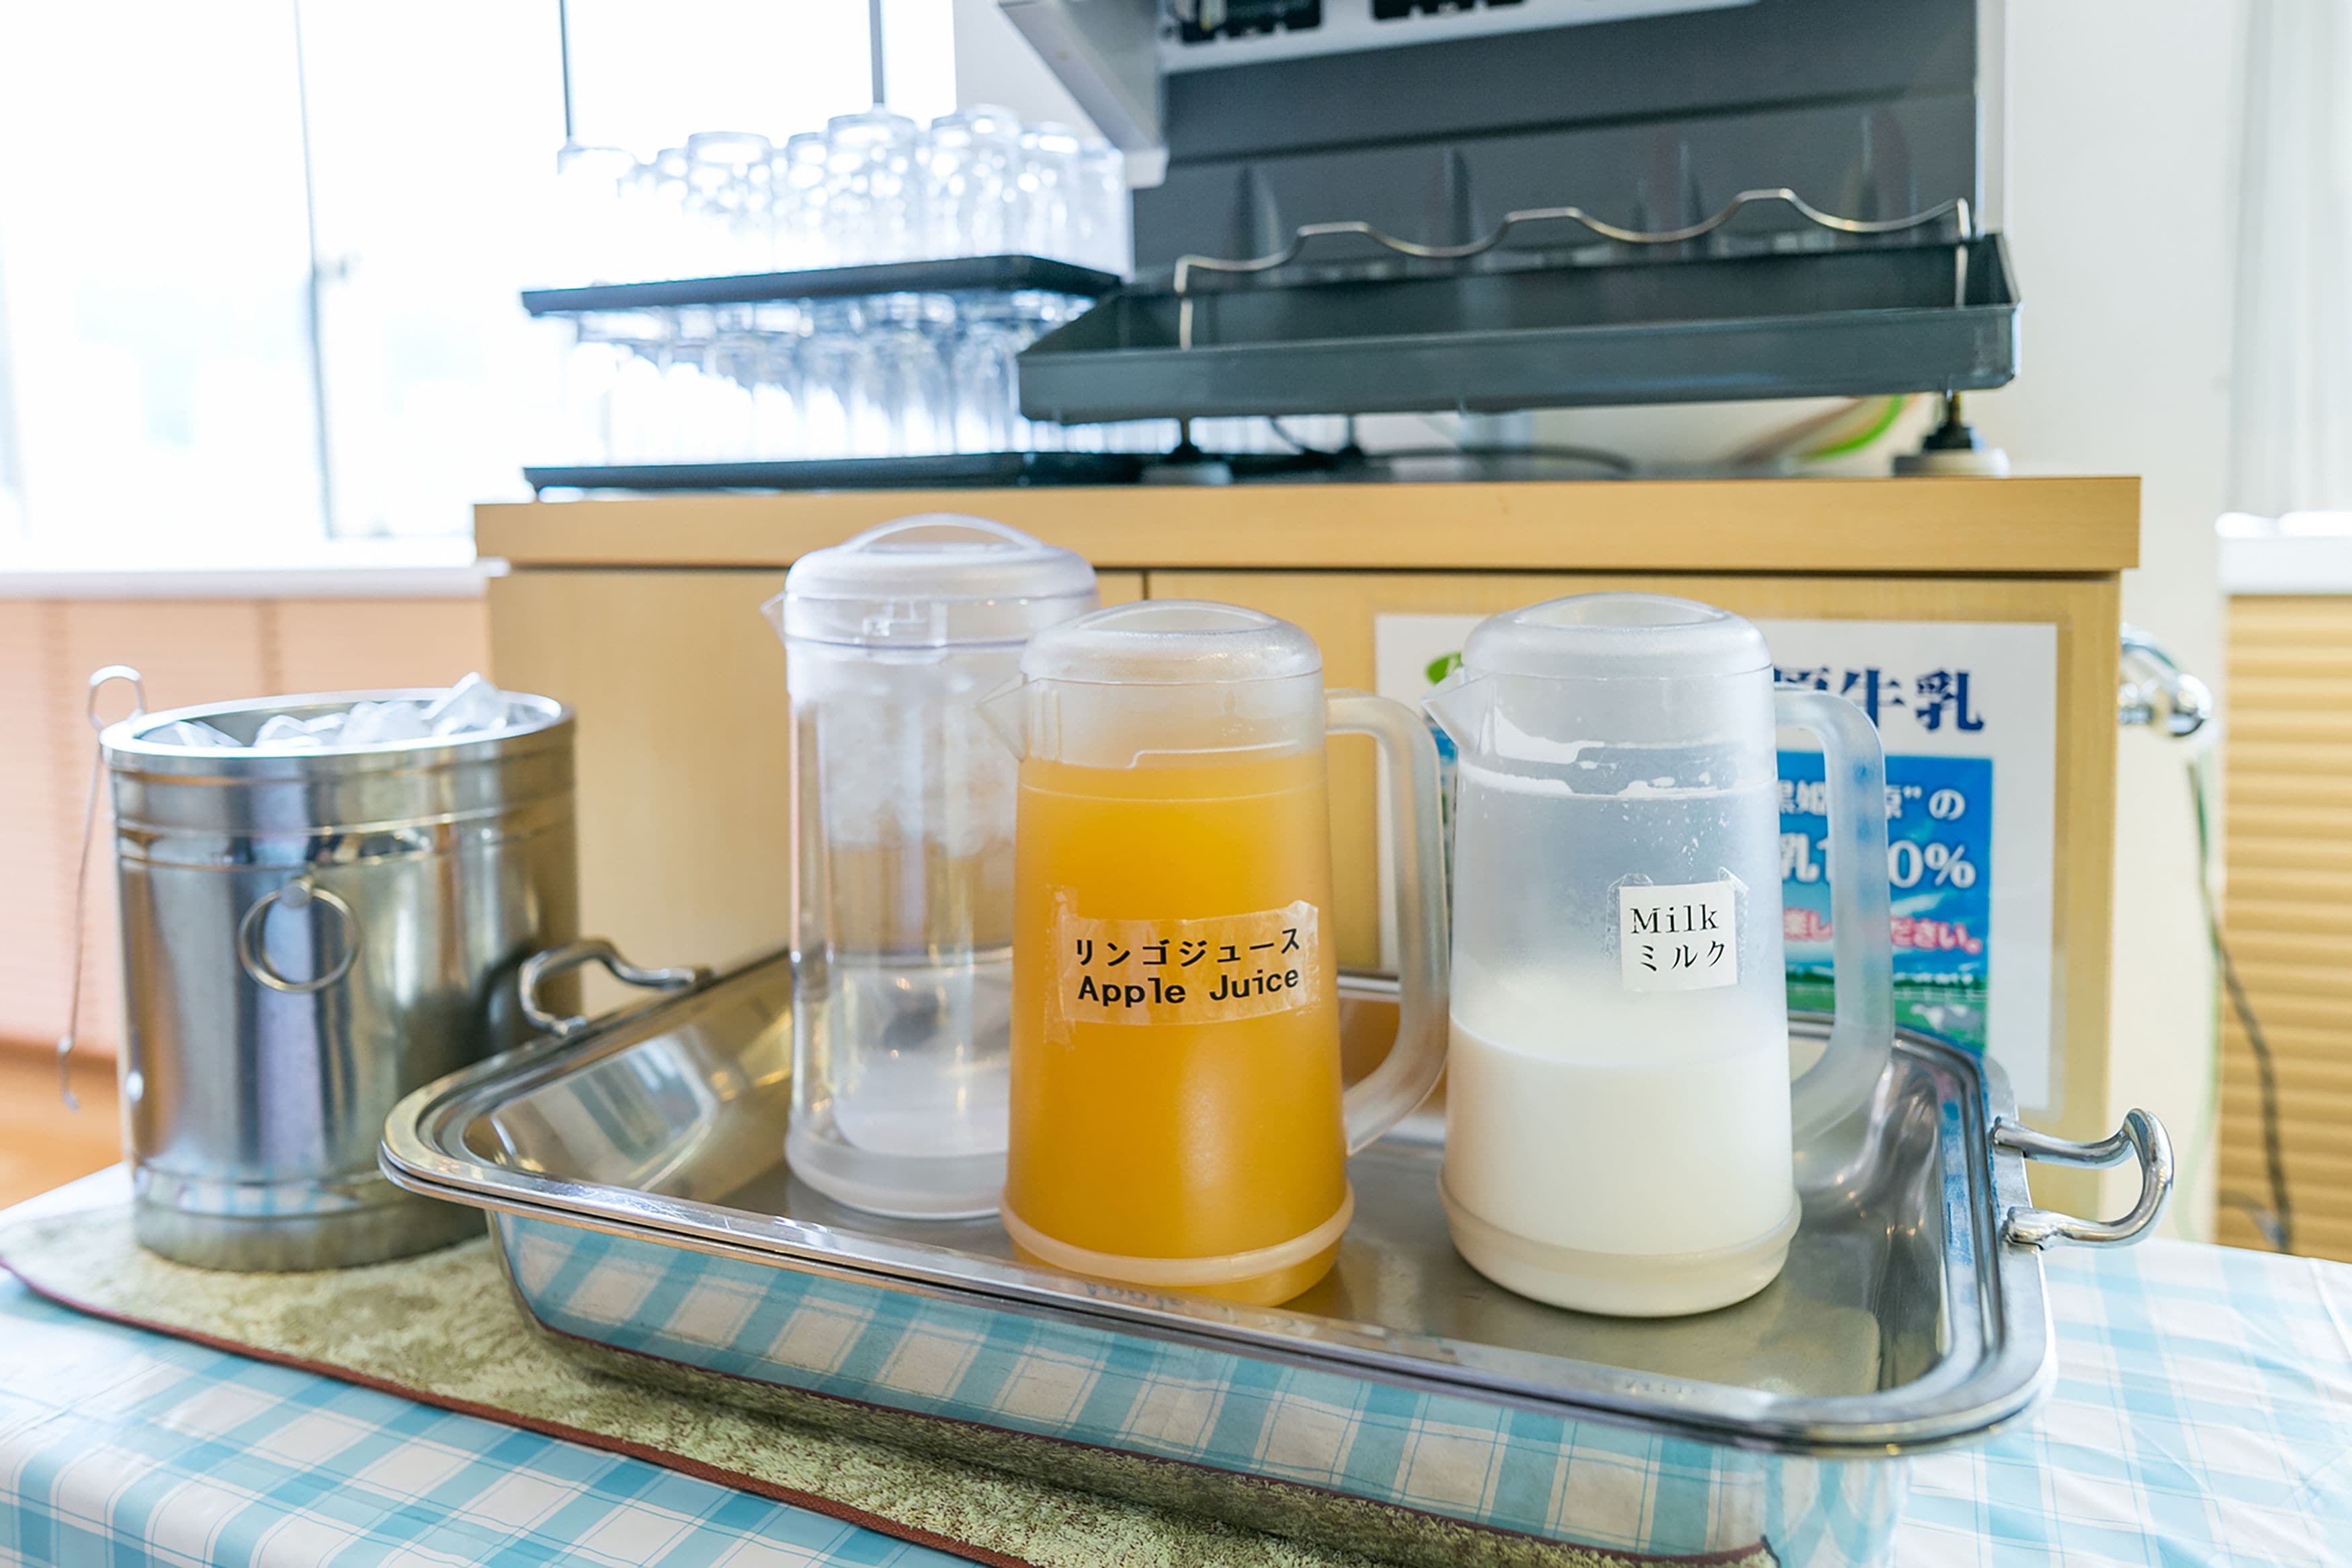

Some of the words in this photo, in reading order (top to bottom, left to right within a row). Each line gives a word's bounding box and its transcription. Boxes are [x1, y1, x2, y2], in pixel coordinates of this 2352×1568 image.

[1630, 904, 1719, 934] Milk
[1076, 928, 1300, 967] リンゴジュース
[1640, 941, 1725, 972] ミルク
[1077, 975, 1186, 1008] Apple
[1209, 968, 1300, 1002] Juice
